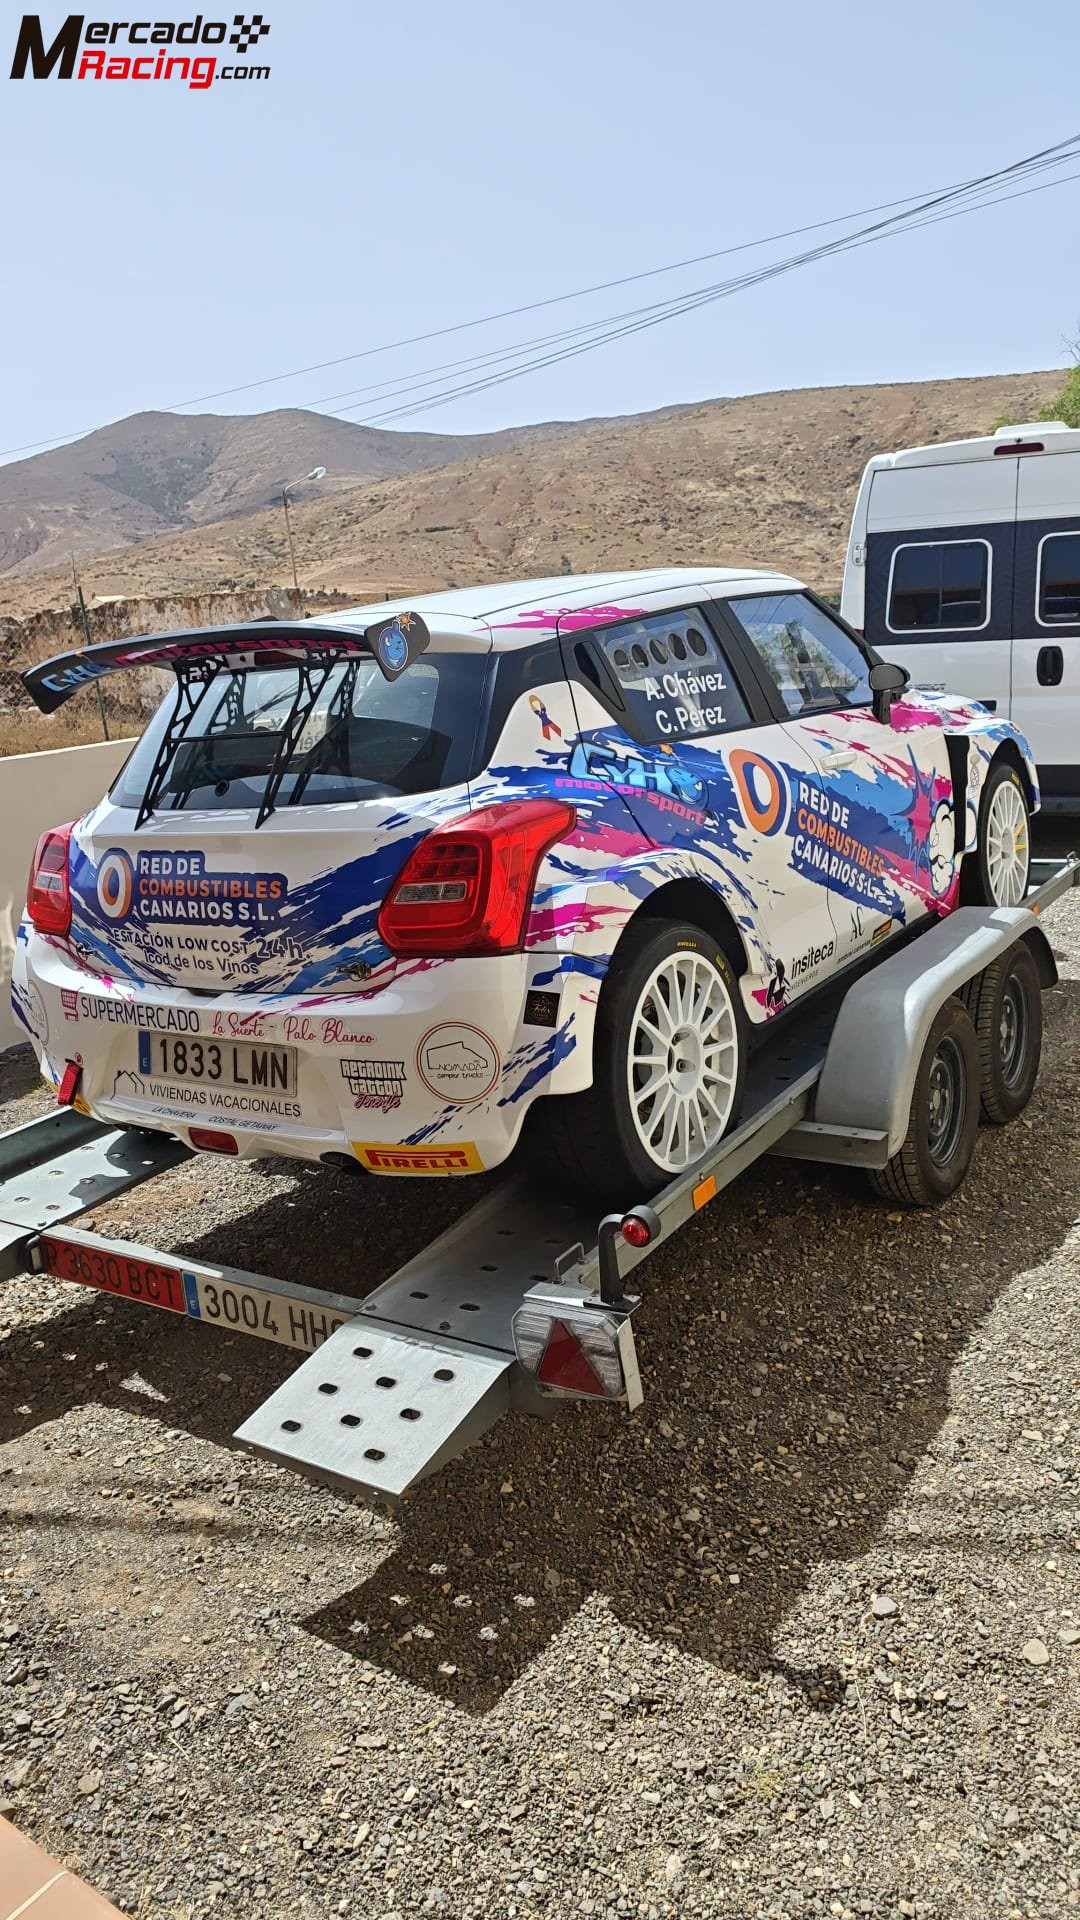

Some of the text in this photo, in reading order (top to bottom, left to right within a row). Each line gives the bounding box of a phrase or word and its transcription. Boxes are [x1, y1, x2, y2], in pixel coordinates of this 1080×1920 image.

[645, 671, 727, 701] A. Chávez
[655, 705, 727, 734] C. Perez
[554, 777, 704, 825] motorsport
[800, 781, 850, 829] RED DE
[798, 808, 885, 878] COMBUSTIBLES
[140, 857, 201, 876] RED DE
[795, 834, 858, 888] CANARIOS
[139, 878, 283, 899] COMBUSTIBLES
[140, 901, 275, 921] CANARIOS S.L.
[178, 936, 209, 951] LOW
[211, 939, 251, 955] COST
[791, 940, 834, 979] insiteca
[144, 952, 259, 975] Icod de los Vinos
[80, 996, 200, 1033] SUPERMERCADO
[212, 1011, 225, 1036] La
[228, 1012, 265, 1038] Suerte
[283, 1016, 316, 1041] Palo
[321, 1017, 375, 1044] Blanco
[159, 1038, 222, 1080] 1833
[233, 1047, 288, 1089] LMN
[150, 1084, 301, 1117] VIVIENDAS VACACIONALES
[365, 1149, 469, 1168] PIRELLI
[64, 1247, 122, 1288] 3630
[127, 1271, 176, 1305] BCT
[204, 1284, 279, 1335] 3004
